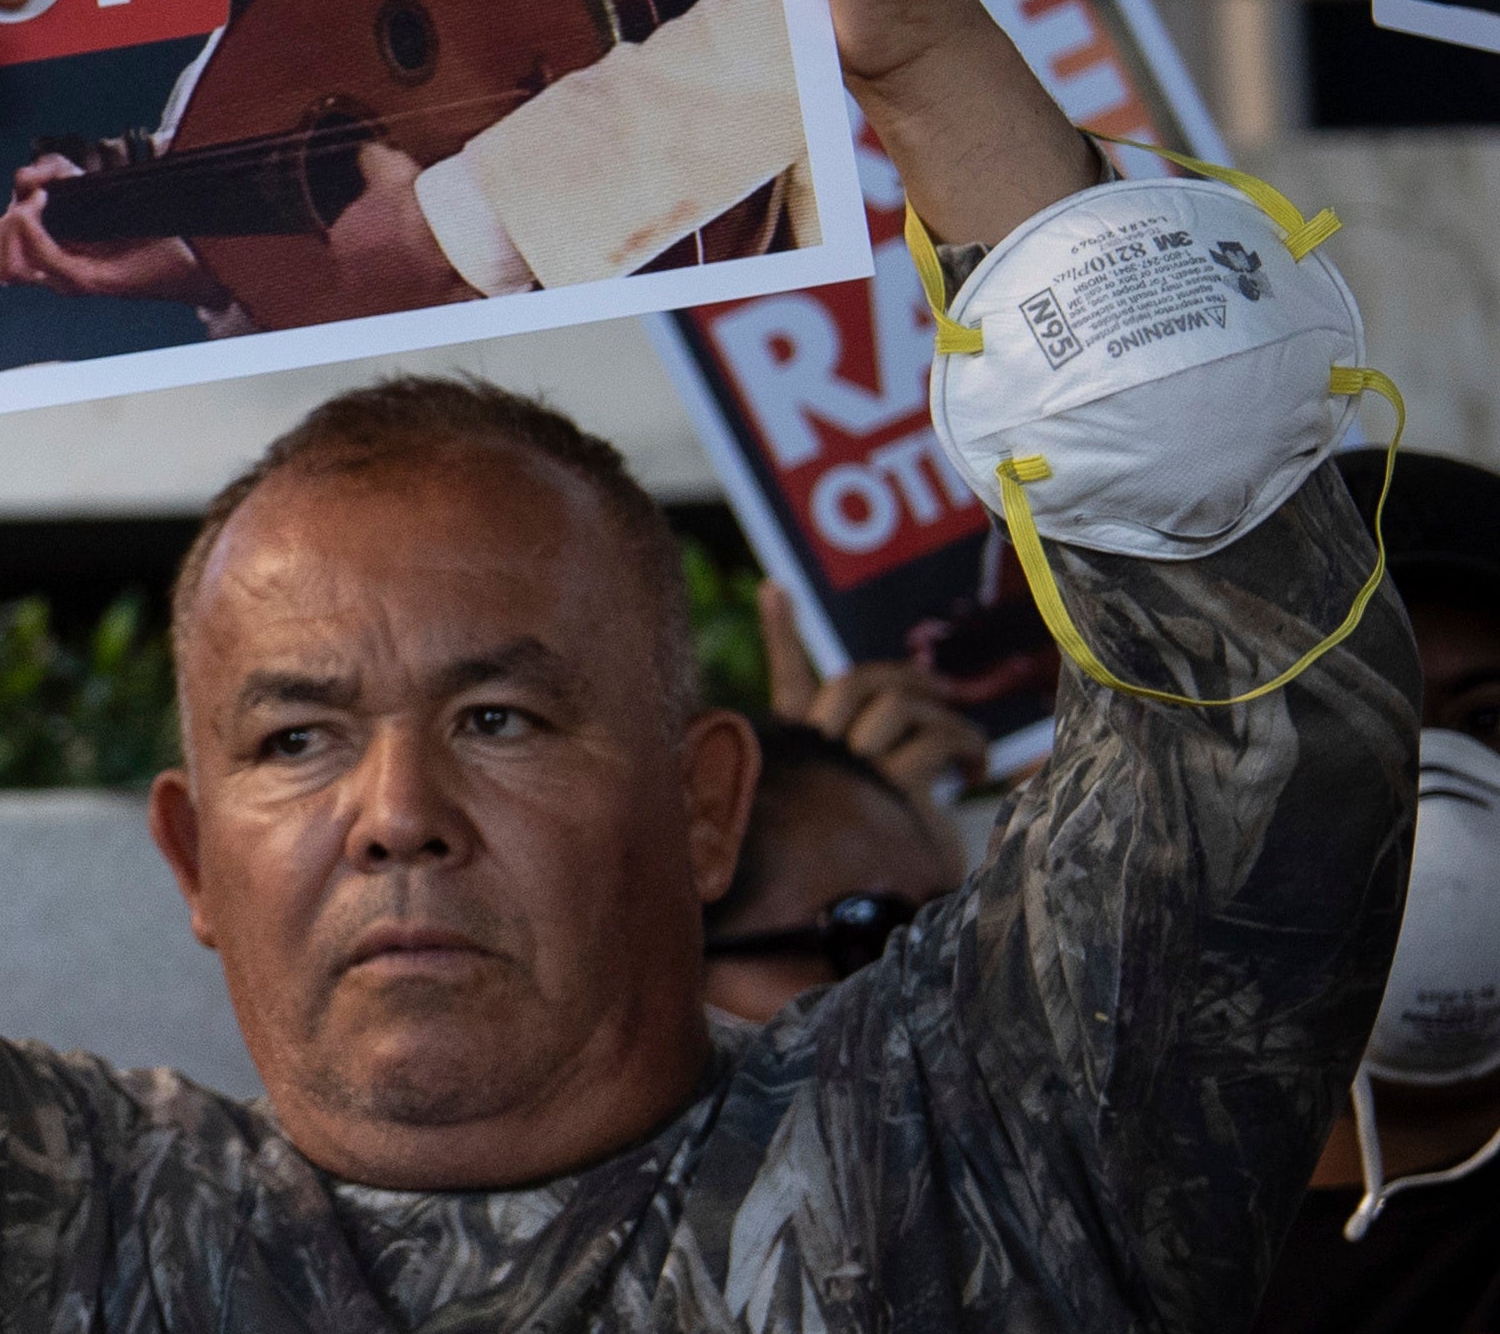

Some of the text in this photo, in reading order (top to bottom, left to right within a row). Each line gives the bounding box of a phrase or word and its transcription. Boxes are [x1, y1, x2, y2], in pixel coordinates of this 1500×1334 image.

[1152, 230, 1193, 252] 3M
[1073, 273, 1107, 294] NIOSH
[1027, 298, 1073, 357] N95
[1108, 311, 1209, 357] WARNING
